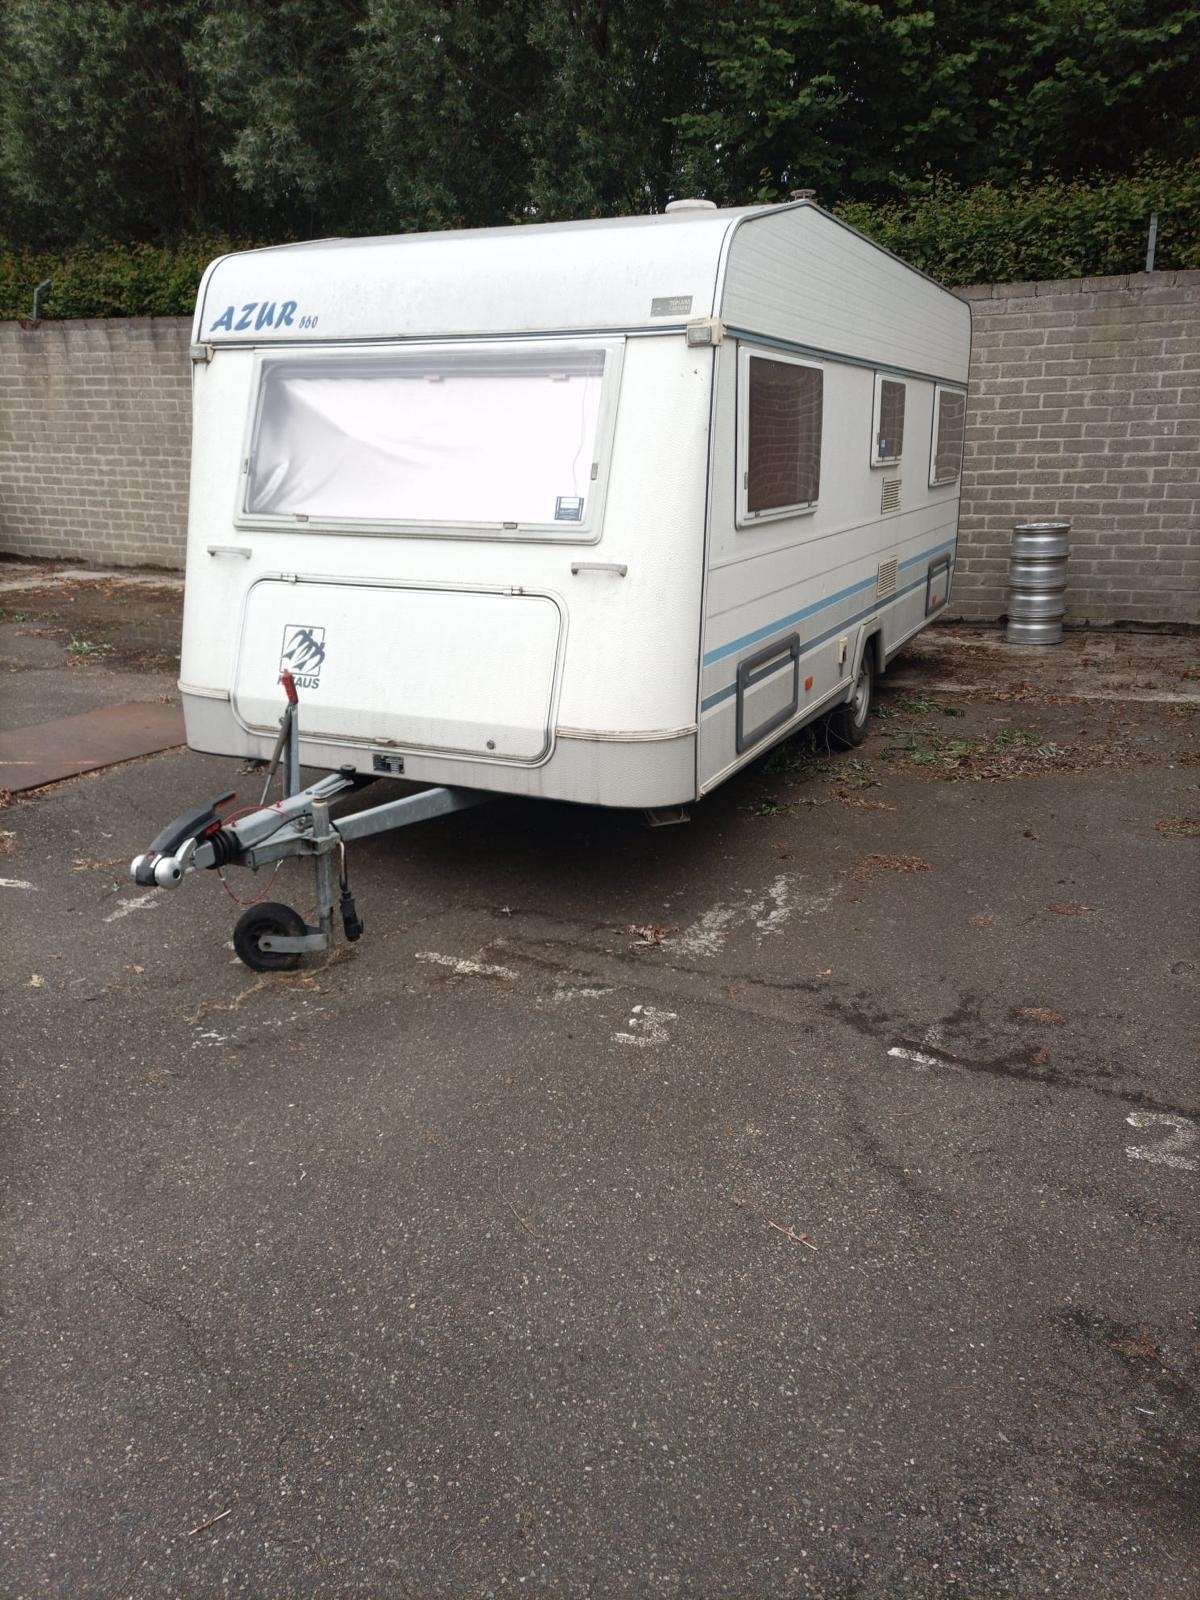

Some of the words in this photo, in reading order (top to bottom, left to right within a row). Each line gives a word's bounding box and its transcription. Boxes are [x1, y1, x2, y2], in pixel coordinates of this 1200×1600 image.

[210, 300, 298, 332] AZUR
[277, 675, 320, 689] AUS
[1126, 1111, 1200, 1171] 2
